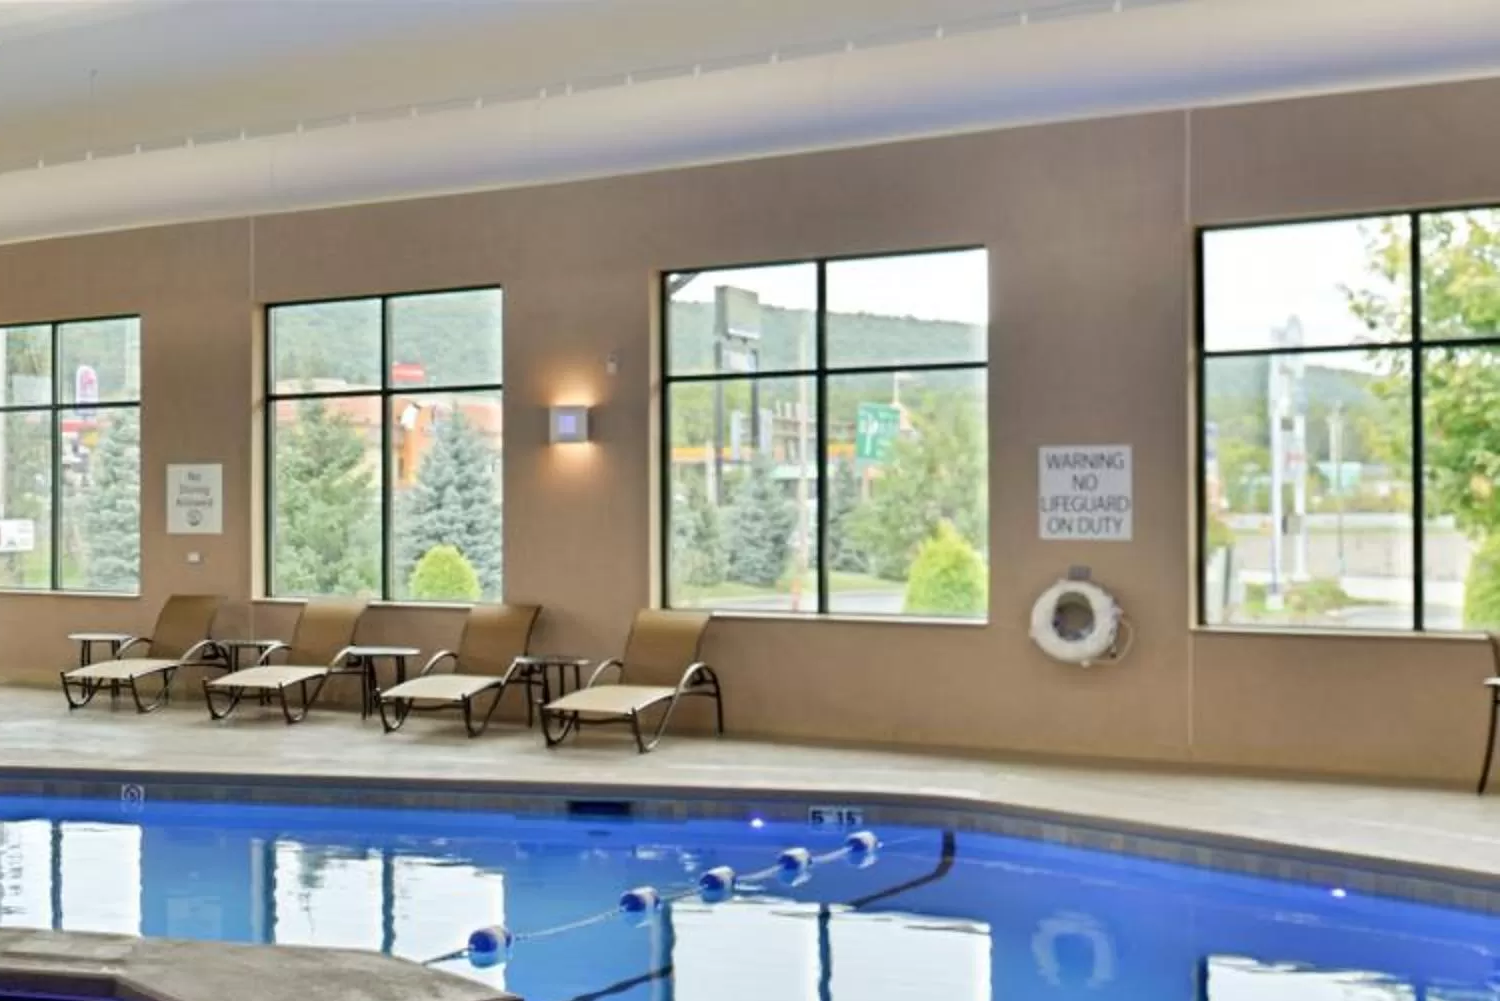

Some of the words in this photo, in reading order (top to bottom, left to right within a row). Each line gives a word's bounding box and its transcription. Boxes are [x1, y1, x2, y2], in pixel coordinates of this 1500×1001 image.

[1045, 452, 1125, 470] WARNING
[1071, 474, 1099, 492] NO
[1040, 496, 1130, 513] LIFEGUARD
[1046, 516, 1073, 534] ON
[1077, 516, 1124, 535] DUTY
